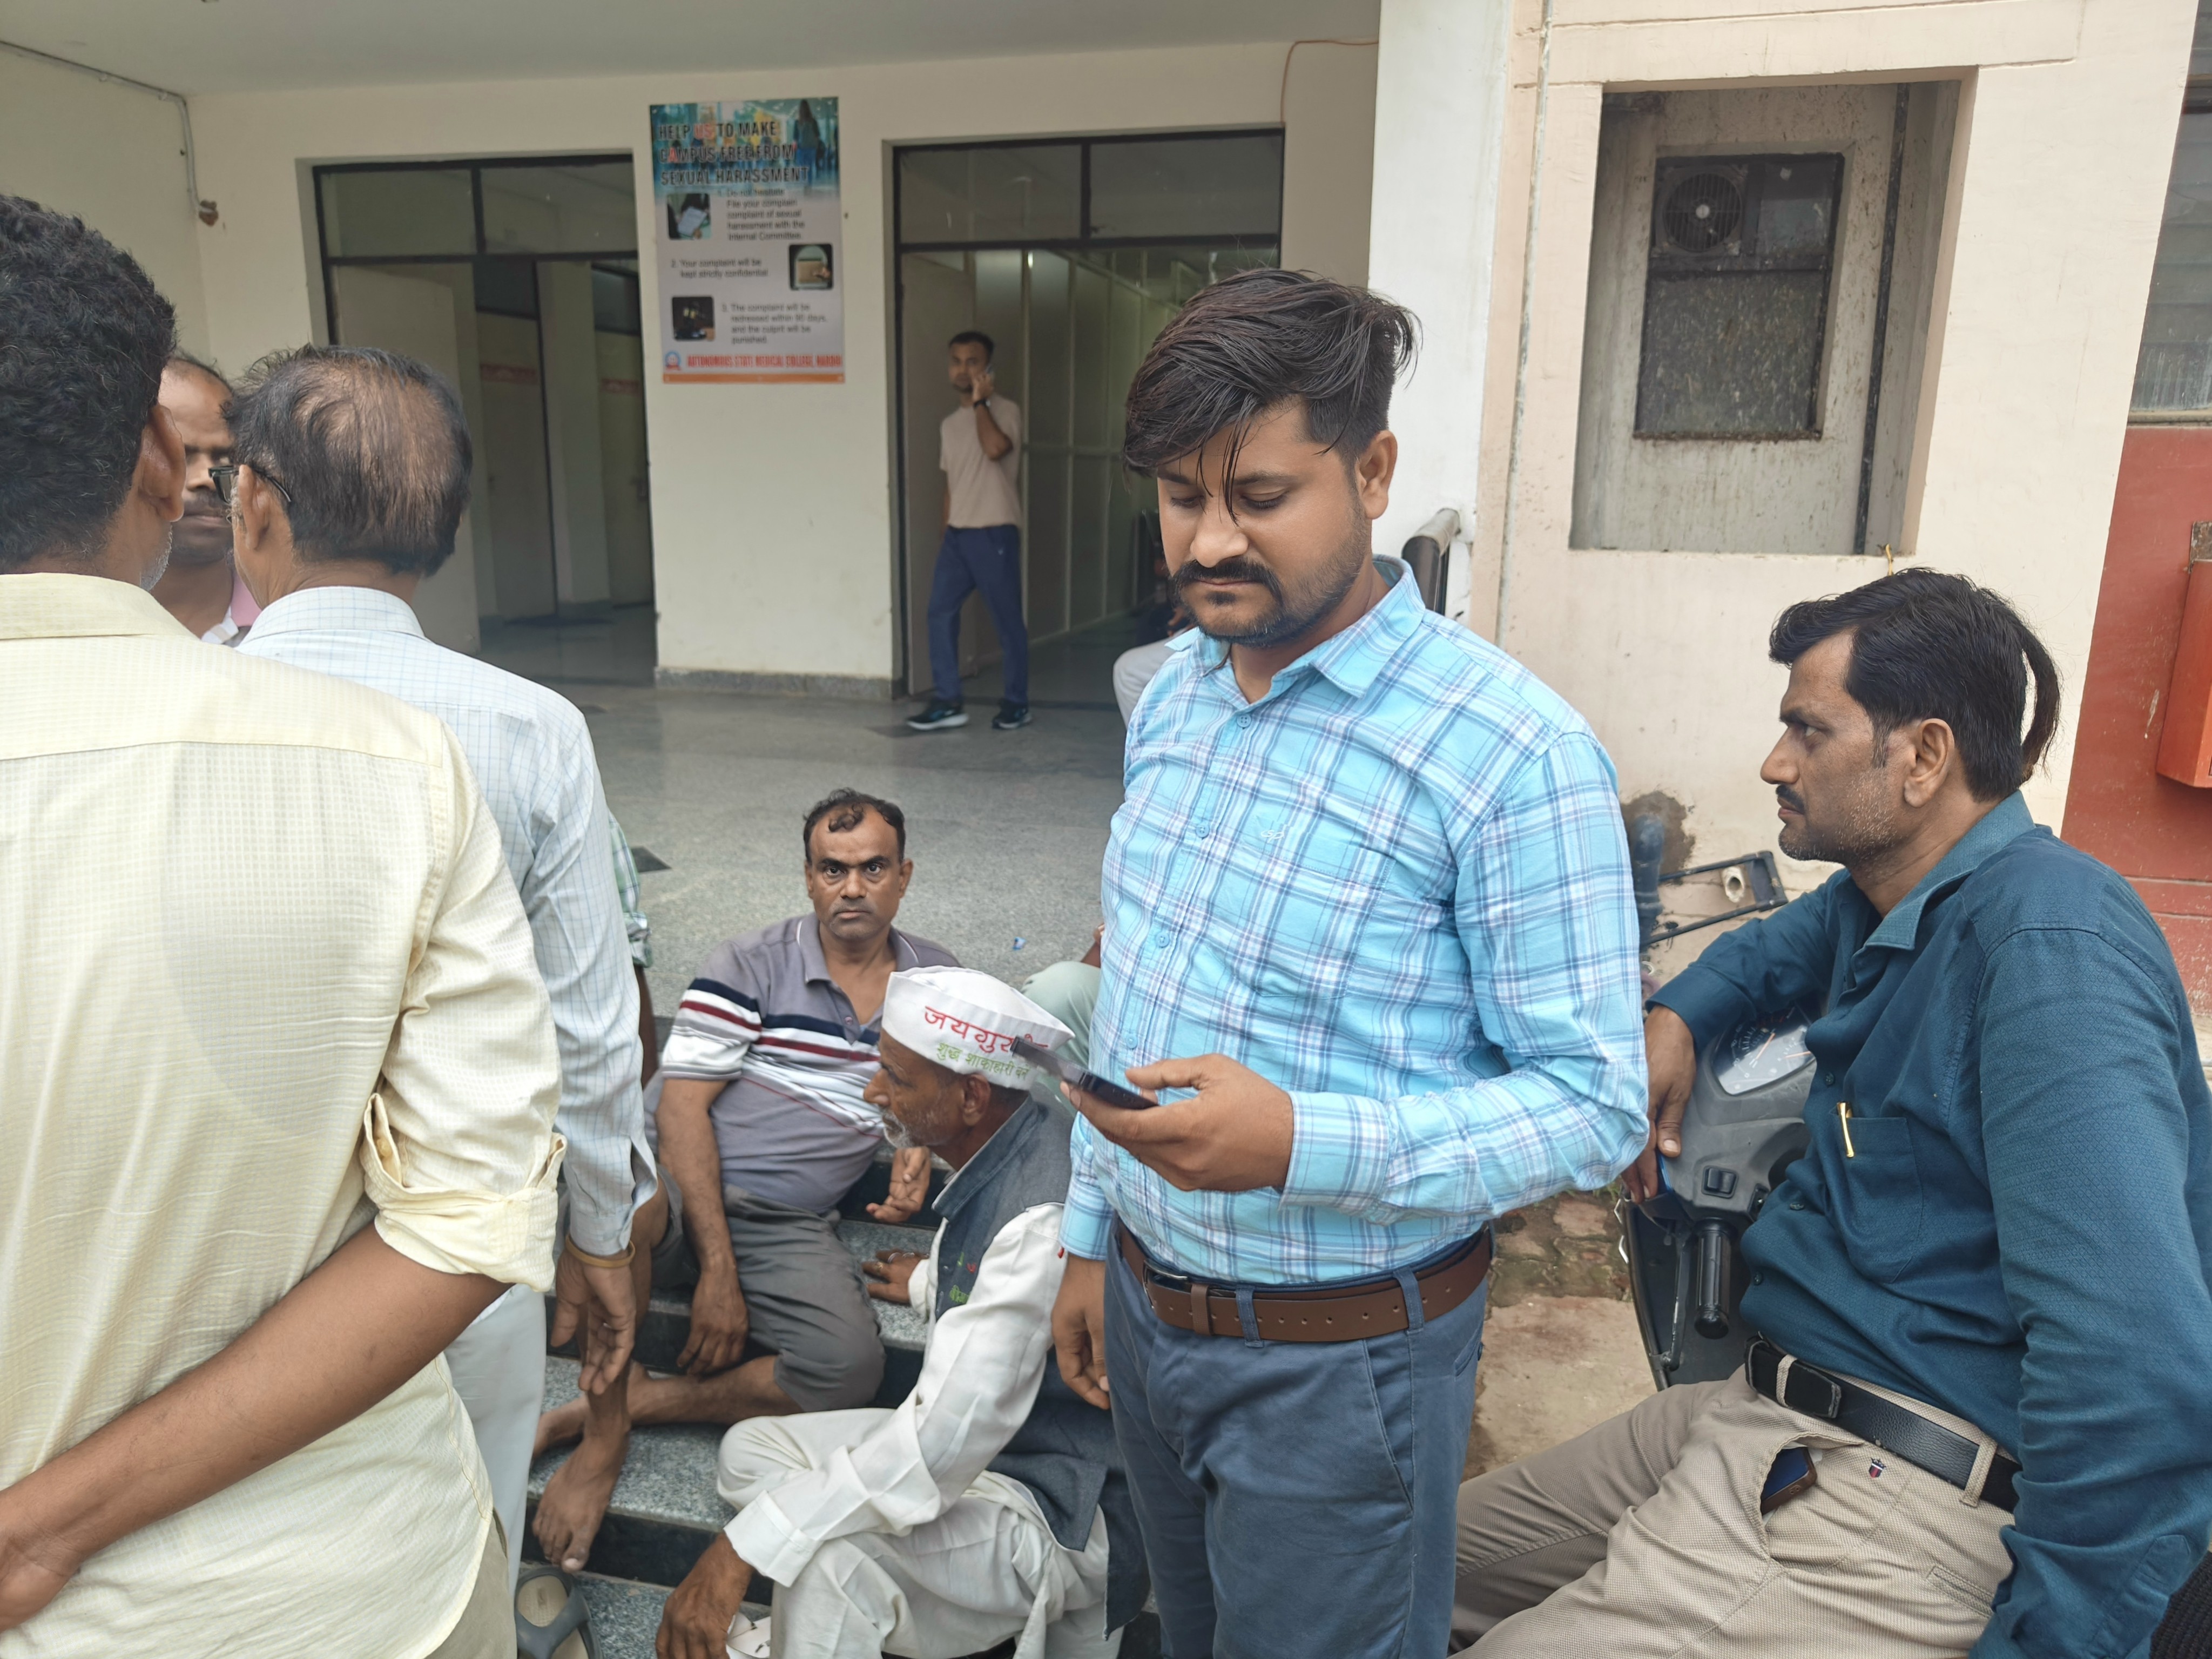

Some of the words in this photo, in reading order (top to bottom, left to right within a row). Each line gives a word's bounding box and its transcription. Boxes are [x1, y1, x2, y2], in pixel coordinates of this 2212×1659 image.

[659, 124, 691, 139] HELP
[693, 123, 714, 137] US
[717, 123, 733, 137] TO
[739, 121, 777, 136] MAKE
[660, 146, 716, 163] CAMPUS
[720, 145, 756, 161] FREE
[756, 144, 795, 160] FROM
[661, 170, 711, 186] SEXUAL
[716, 166, 809, 184] HARASSMENT
[965, 1052, 1015, 1076] शाकाहारी
